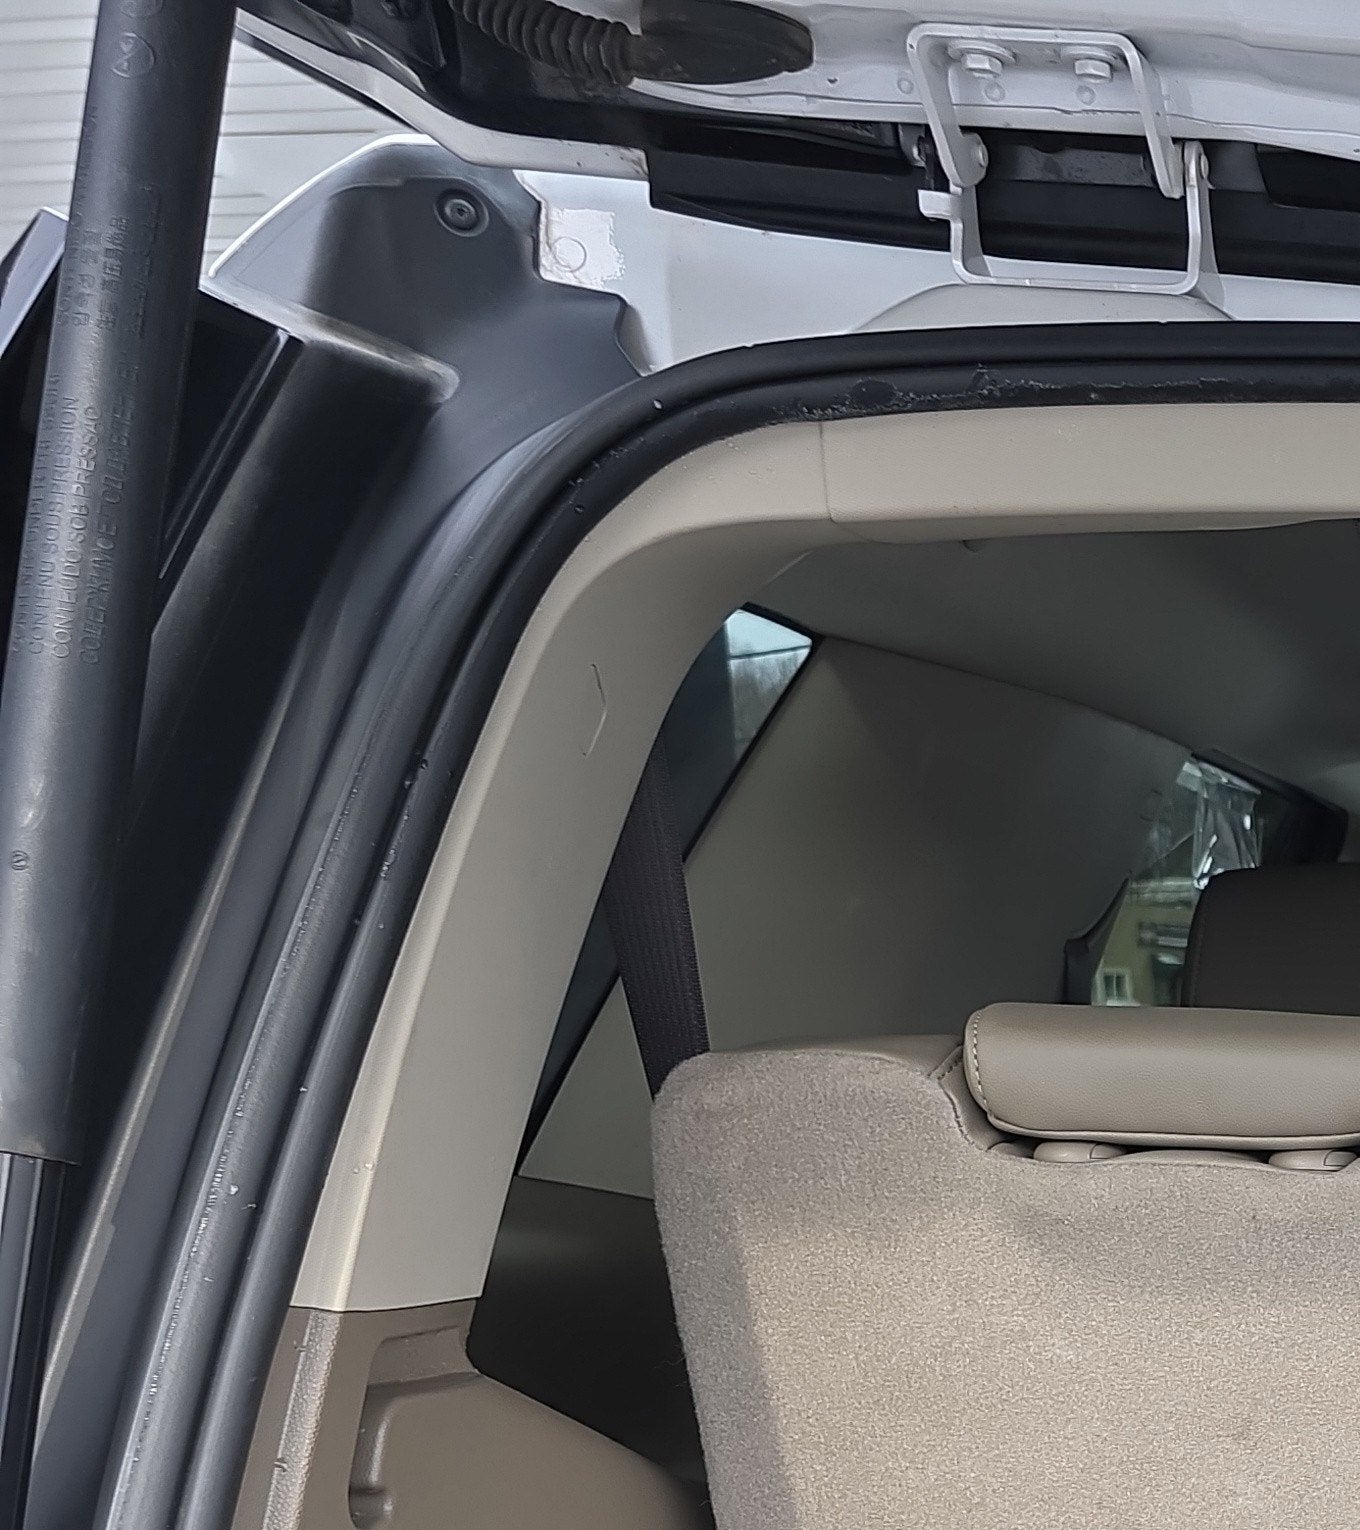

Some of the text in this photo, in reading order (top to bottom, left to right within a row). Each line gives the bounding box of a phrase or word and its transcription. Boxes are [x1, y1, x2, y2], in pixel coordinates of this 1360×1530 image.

[29, 396, 80, 654] CONTENU SOUS PRESSION
[68, 502, 90, 543] SOB
